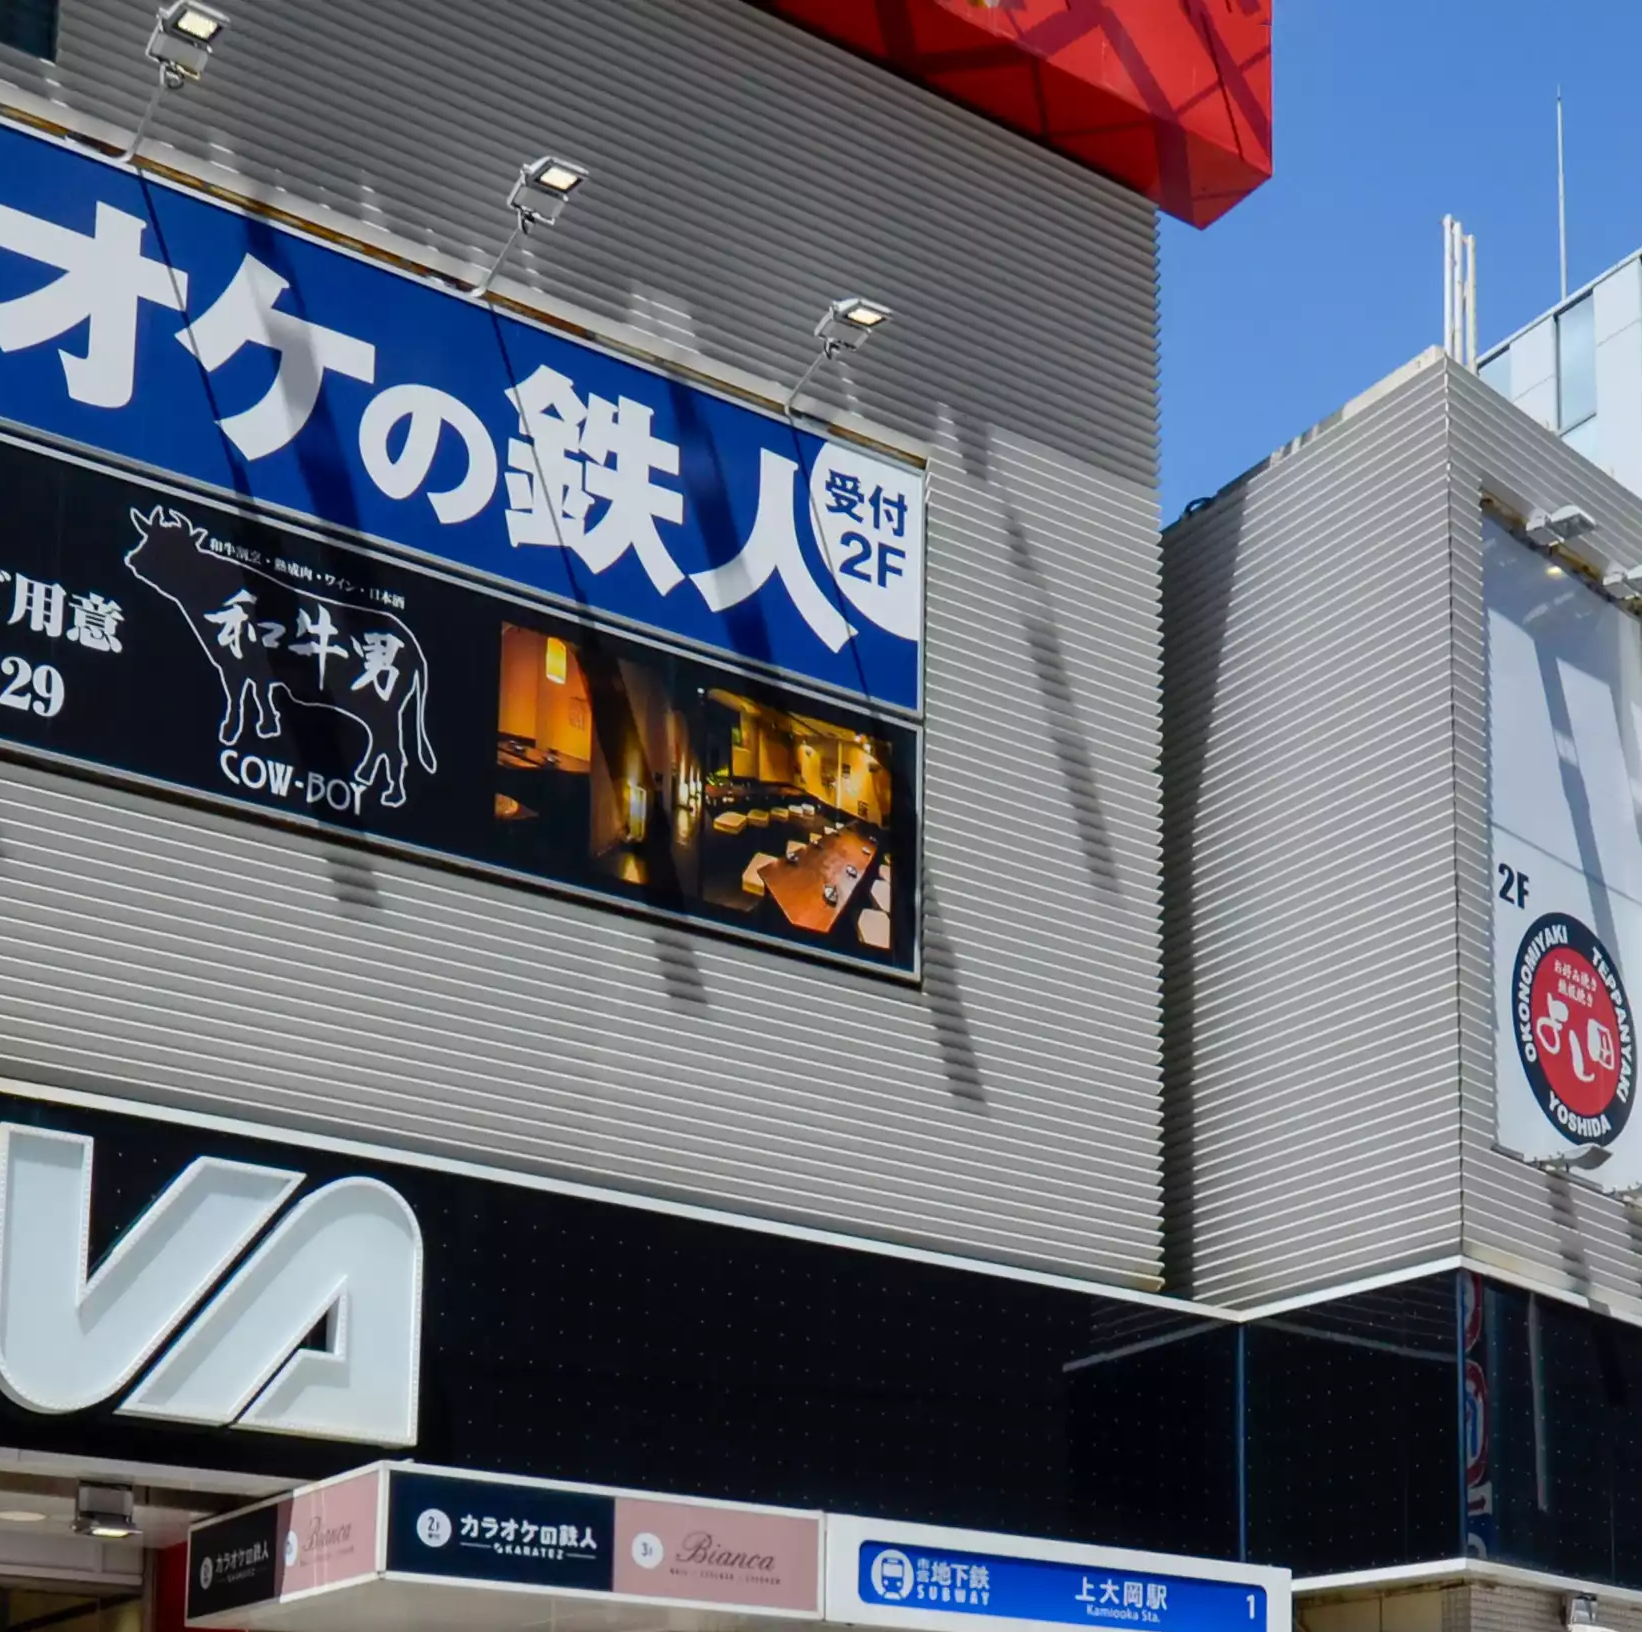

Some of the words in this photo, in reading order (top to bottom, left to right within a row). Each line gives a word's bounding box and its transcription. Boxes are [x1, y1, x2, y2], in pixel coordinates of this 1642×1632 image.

[821, 467, 909, 541] 受付
[837, 534, 906, 589] 2F
[204, 588, 405, 702] 和牛男
[1497, 863, 1531, 910] 2F
[1516, 924, 1569, 1063] OKONOMIYAKI
[1589, 944, 1635, 1104] TEPPANYAKI
[1548, 1090, 1612, 1137] YOSHIDA
[459, 1513, 598, 1550] カラオケの鉄人
[675, 1530, 776, 1572] Bianca
[916, 1584, 990, 1606] SUBWAY
[1074, 1575, 1168, 1611] 上大岡駅
[1086, 1602, 1139, 1621] Kamiooka
[1245, 1594, 1256, 1620] 1
